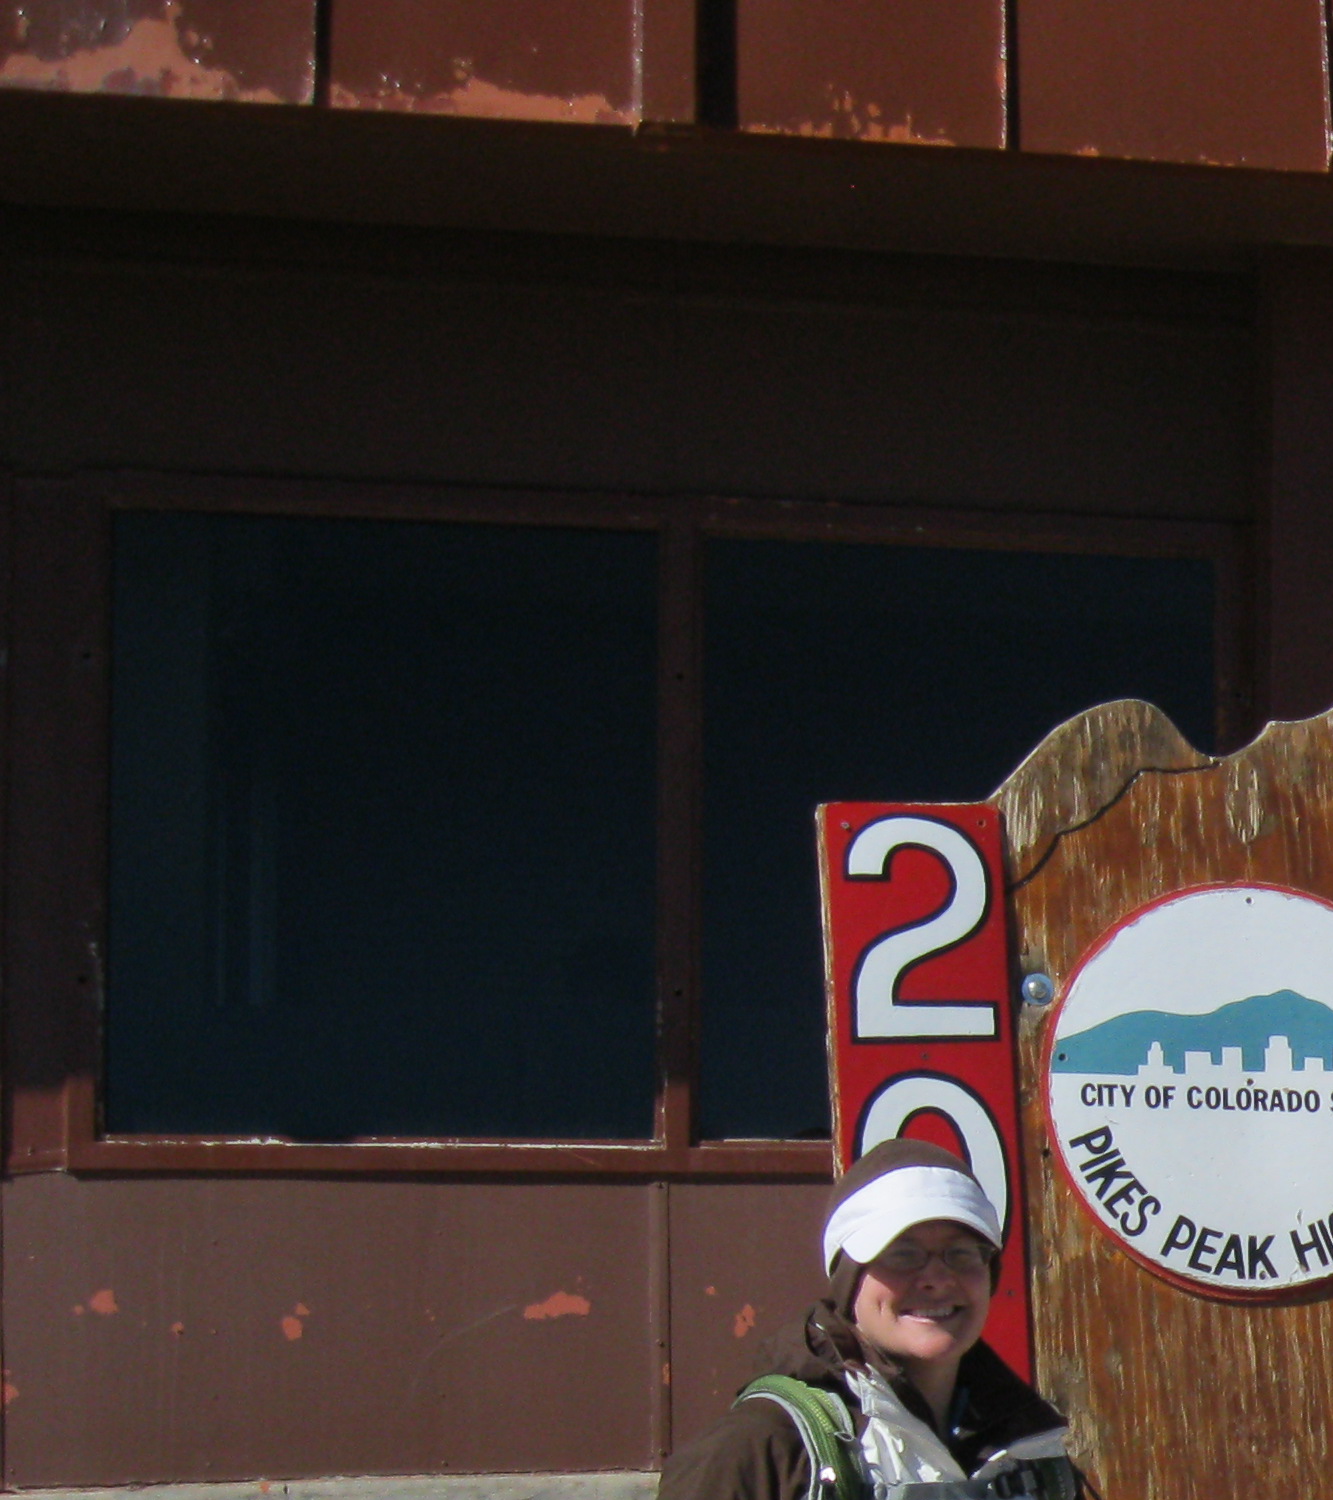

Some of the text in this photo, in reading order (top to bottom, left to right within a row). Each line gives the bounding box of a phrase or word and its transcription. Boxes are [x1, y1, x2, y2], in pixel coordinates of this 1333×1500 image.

[1080, 1082, 1136, 1109] CITY
[1145, 1085, 1175, 1109] OF
[1187, 1085, 1321, 1113] COLORADO
[1068, 1124, 1162, 1237] PIKES
[1159, 1214, 1279, 1281] PEAK
